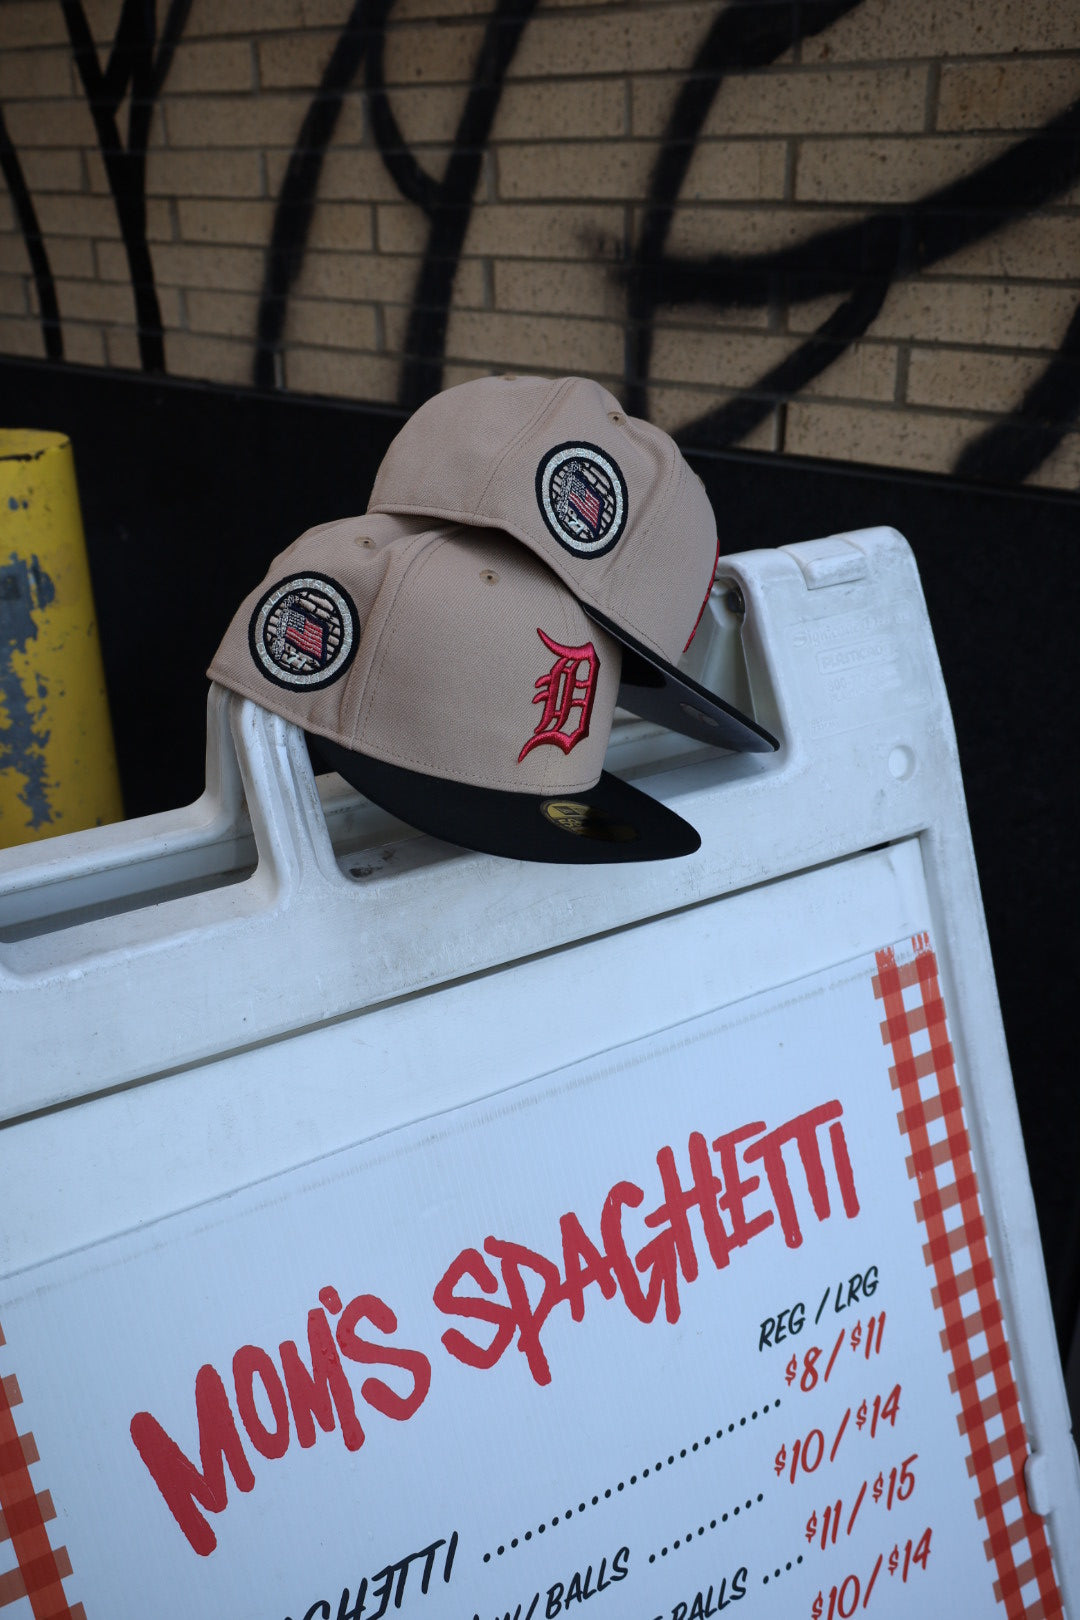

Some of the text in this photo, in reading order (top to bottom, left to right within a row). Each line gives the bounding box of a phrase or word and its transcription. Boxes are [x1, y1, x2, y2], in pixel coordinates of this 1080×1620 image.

[517, 627, 601, 764] D
[129, 1099, 861, 1557] MOM'S SPAGHETTI
[758, 1302, 806, 1352] REG
[834, 1265, 879, 1313] LRG
